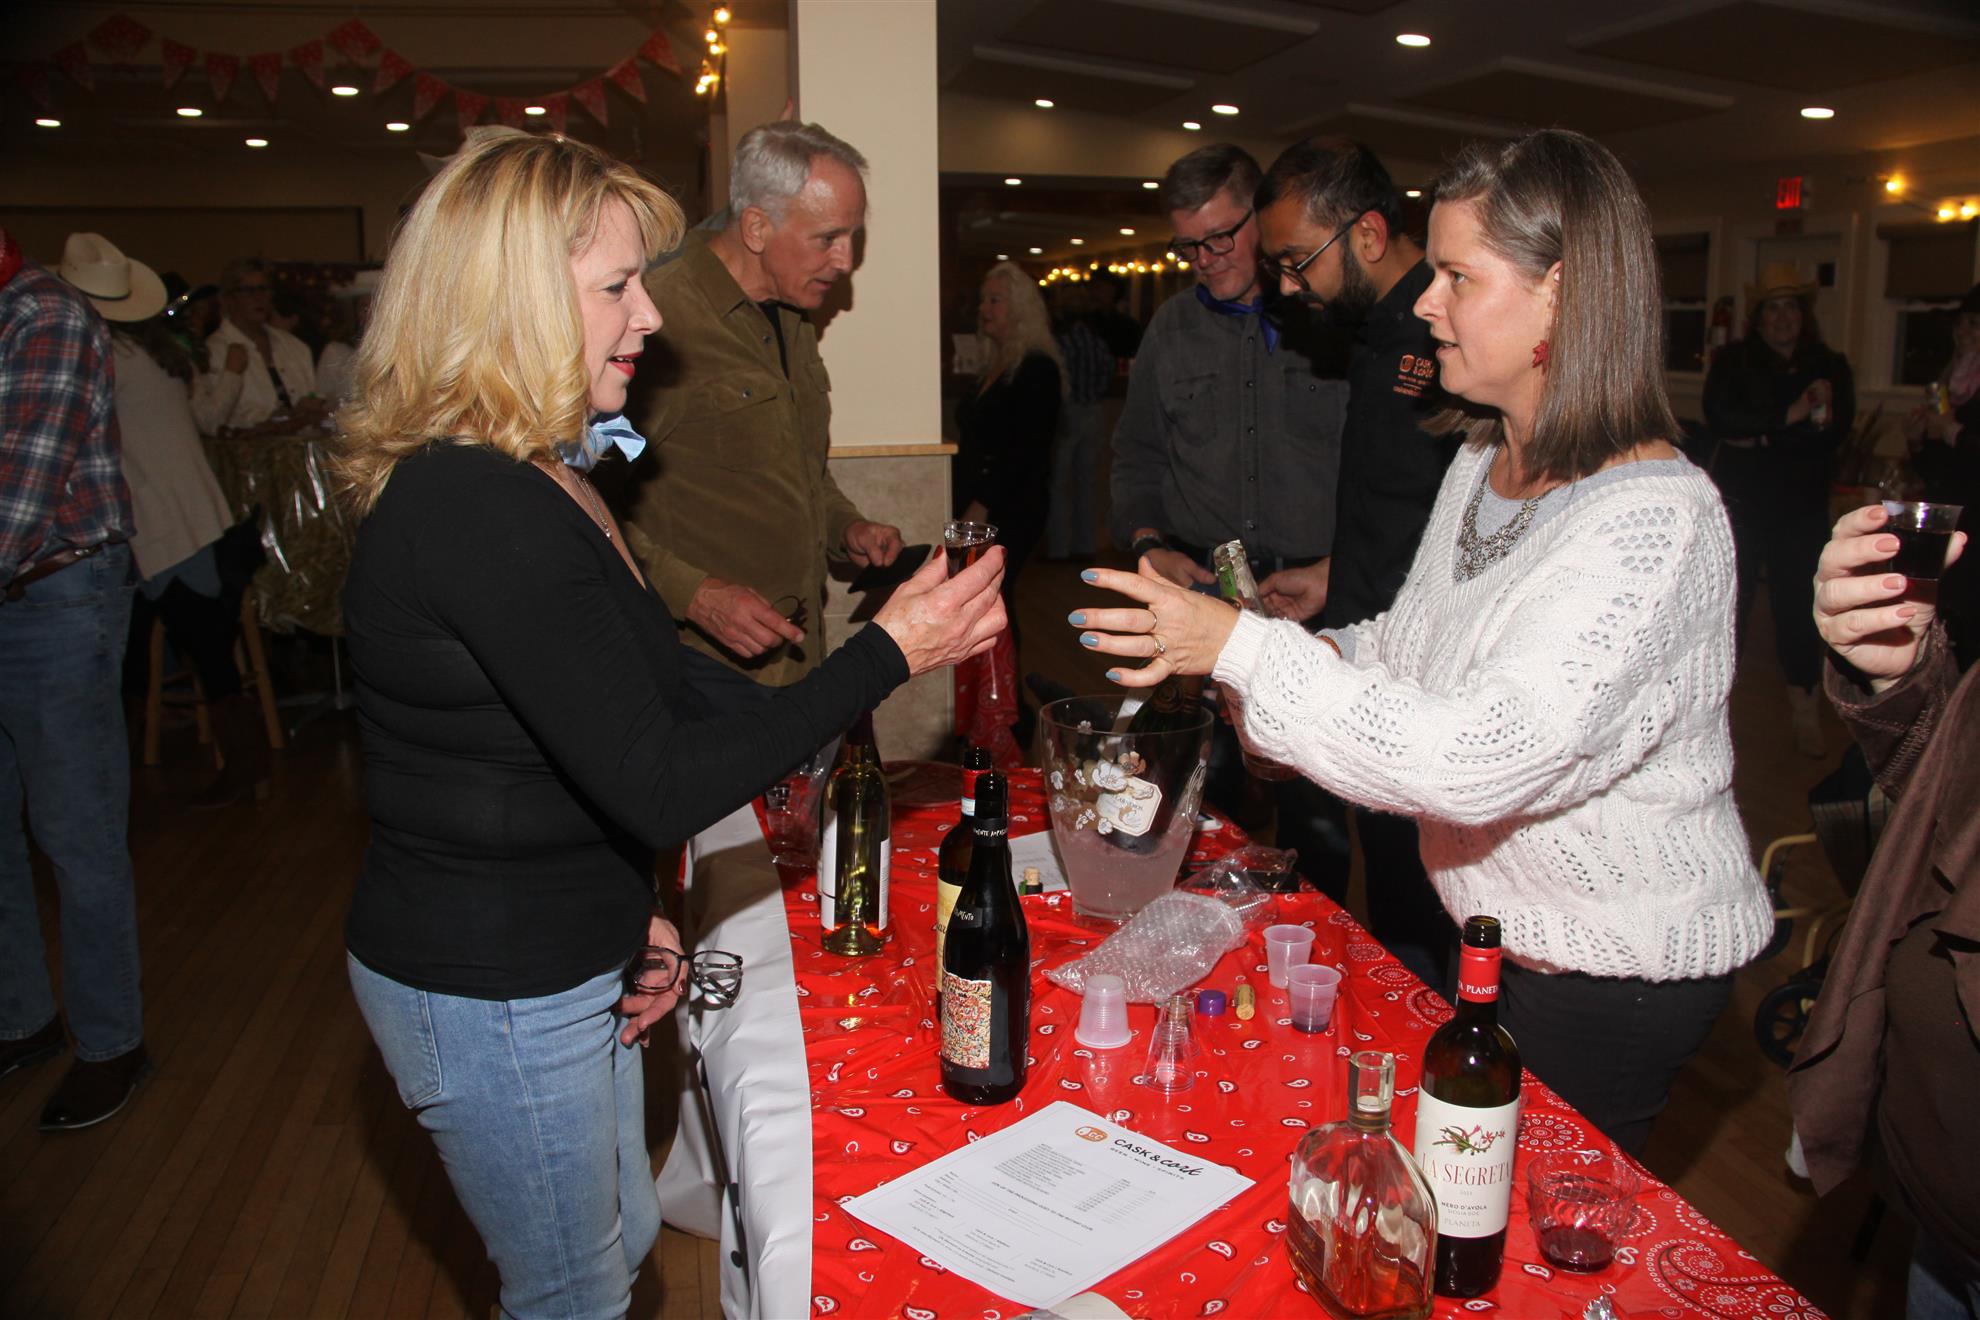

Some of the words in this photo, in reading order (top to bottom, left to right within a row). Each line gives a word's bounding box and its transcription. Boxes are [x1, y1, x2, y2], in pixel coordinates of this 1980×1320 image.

[1776, 176, 1803, 209] EXIT
[1114, 1138, 1151, 1157] CASK
[1160, 1159, 1204, 1176] cork
[1421, 1152, 1437, 1178] LA
[1441, 1201, 1459, 1210] NERO
[1444, 1217, 1481, 1228] PLANETA
